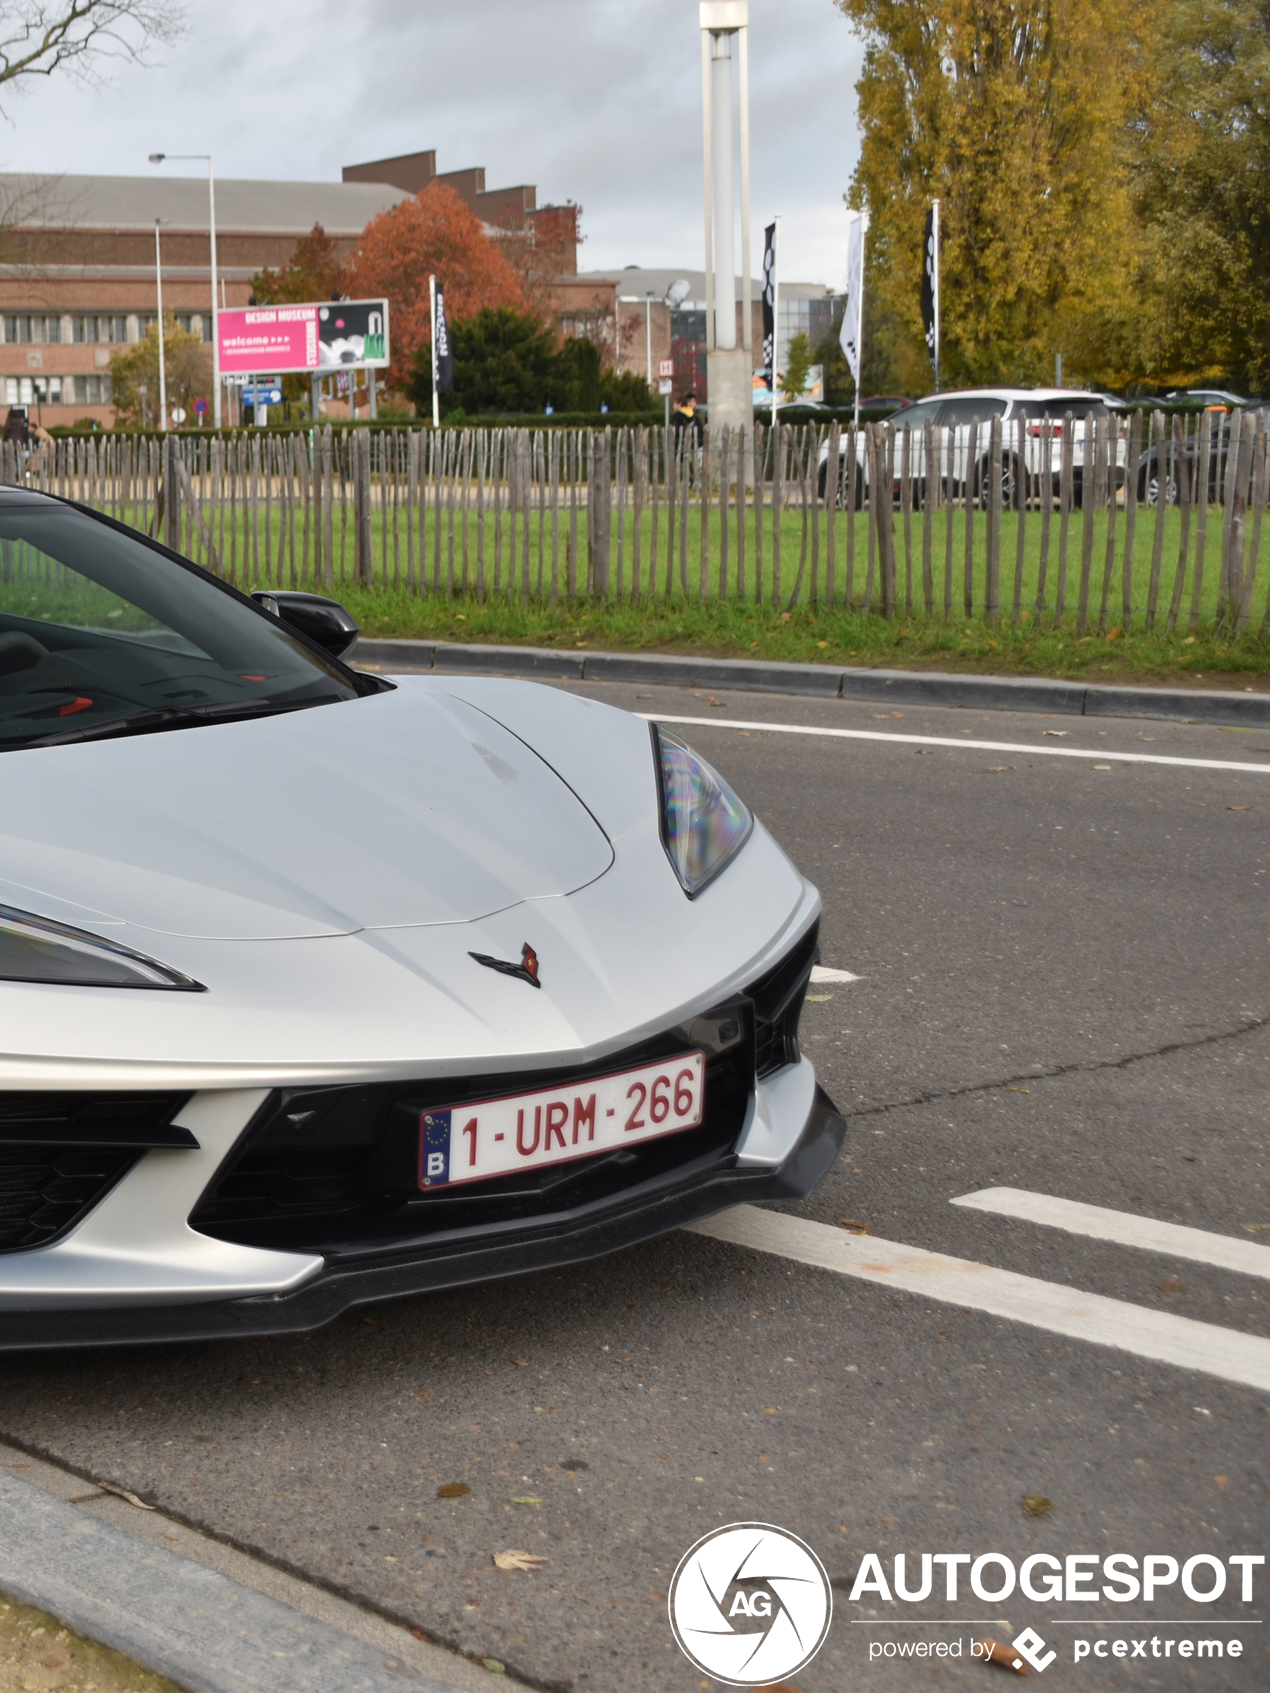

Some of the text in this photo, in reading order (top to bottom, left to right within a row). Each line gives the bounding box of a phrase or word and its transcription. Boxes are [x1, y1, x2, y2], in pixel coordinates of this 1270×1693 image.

[245, 308, 316, 324] DESIGN MUSEUM
[222, 336, 269, 347] welcome
[305, 321, 317, 366] BRUSSELS
[462, 1068, 694, 1167] 1-URM-266
[427, 1152, 445, 1176] B
